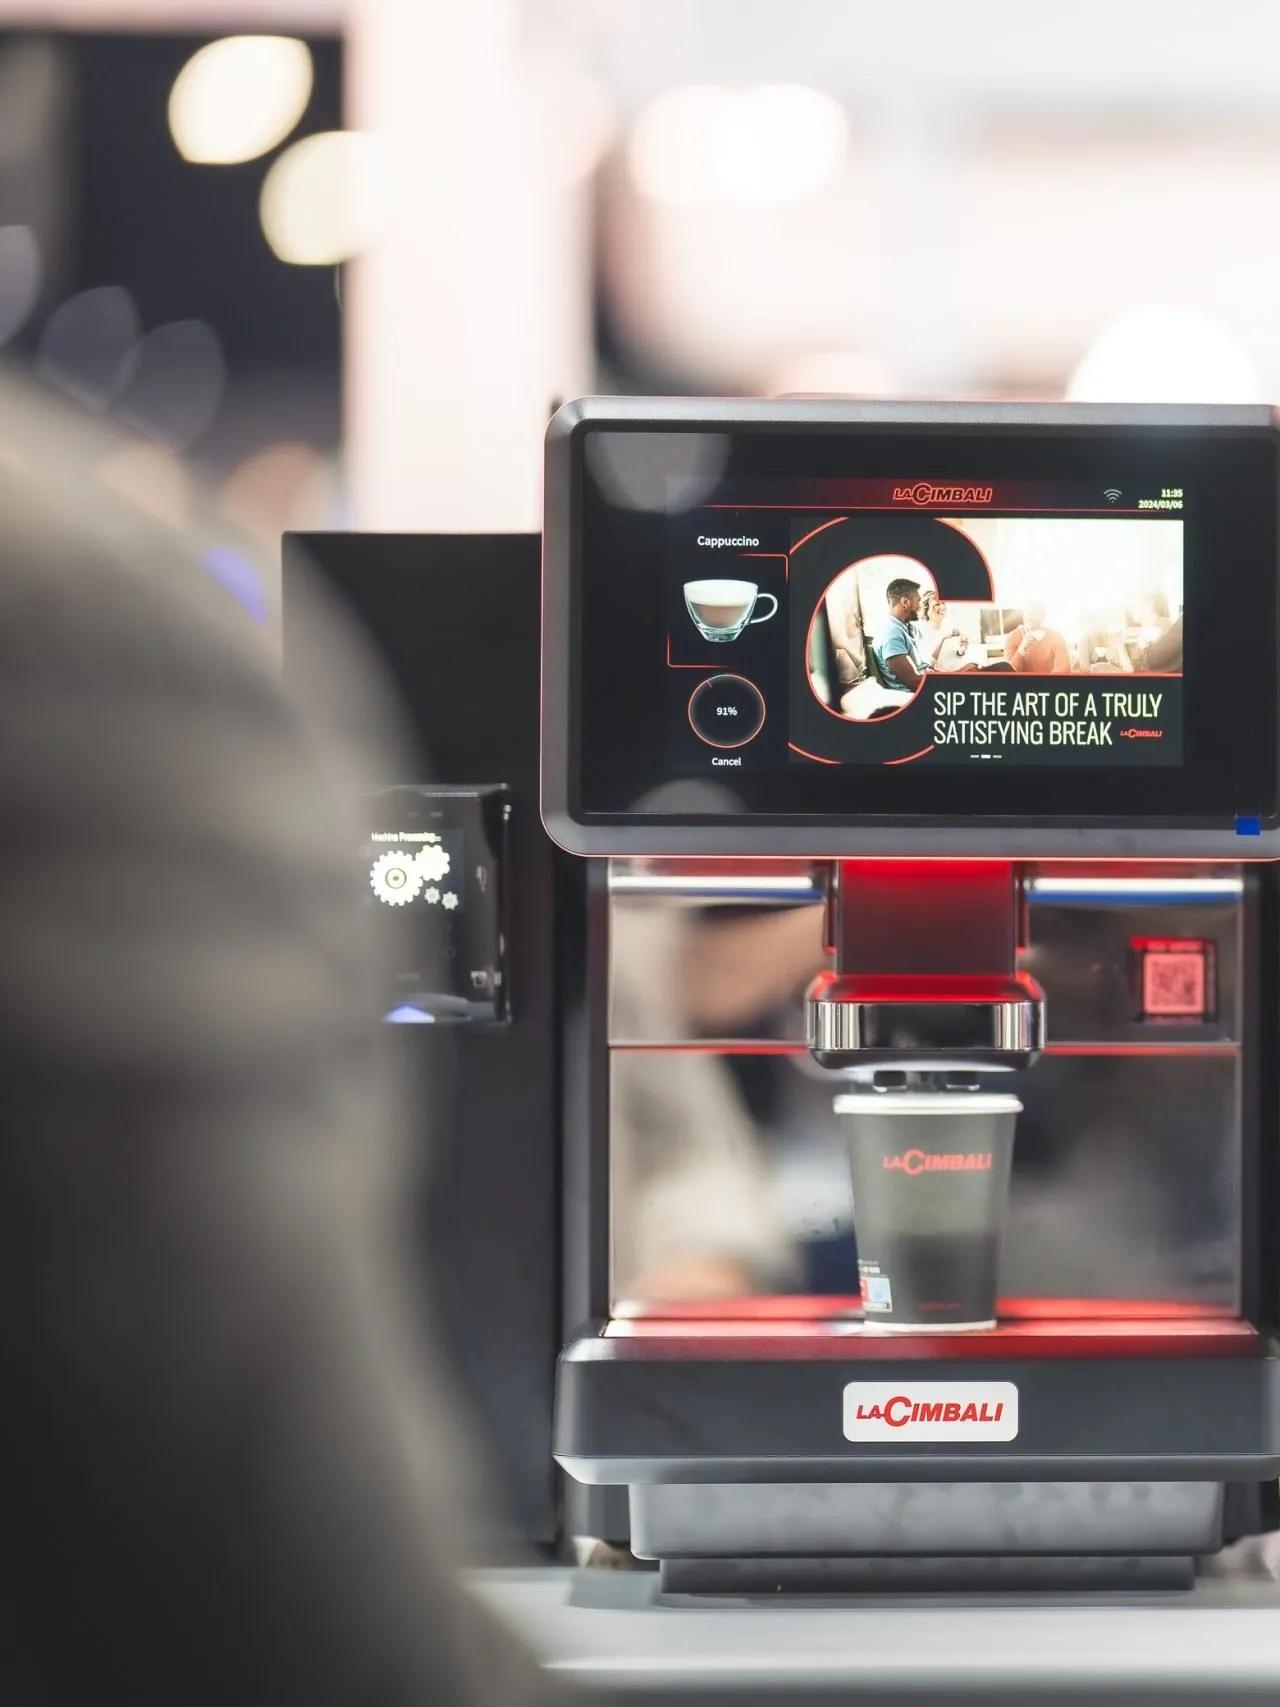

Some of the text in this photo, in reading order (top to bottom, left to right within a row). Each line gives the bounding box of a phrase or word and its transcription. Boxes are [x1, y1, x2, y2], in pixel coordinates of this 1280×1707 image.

[1161, 488, 1183, 498] 11:35
[1138, 500, 1183, 510] 2024/03/06
[697, 535, 760, 549] Cappuccino
[933, 691, 1163, 718] SIP THE ART OF A TRULY
[716, 706, 738, 716] 91%
[933, 720, 1113, 746] SATISFYING BREAK
[711, 756, 742, 767] Cancel
